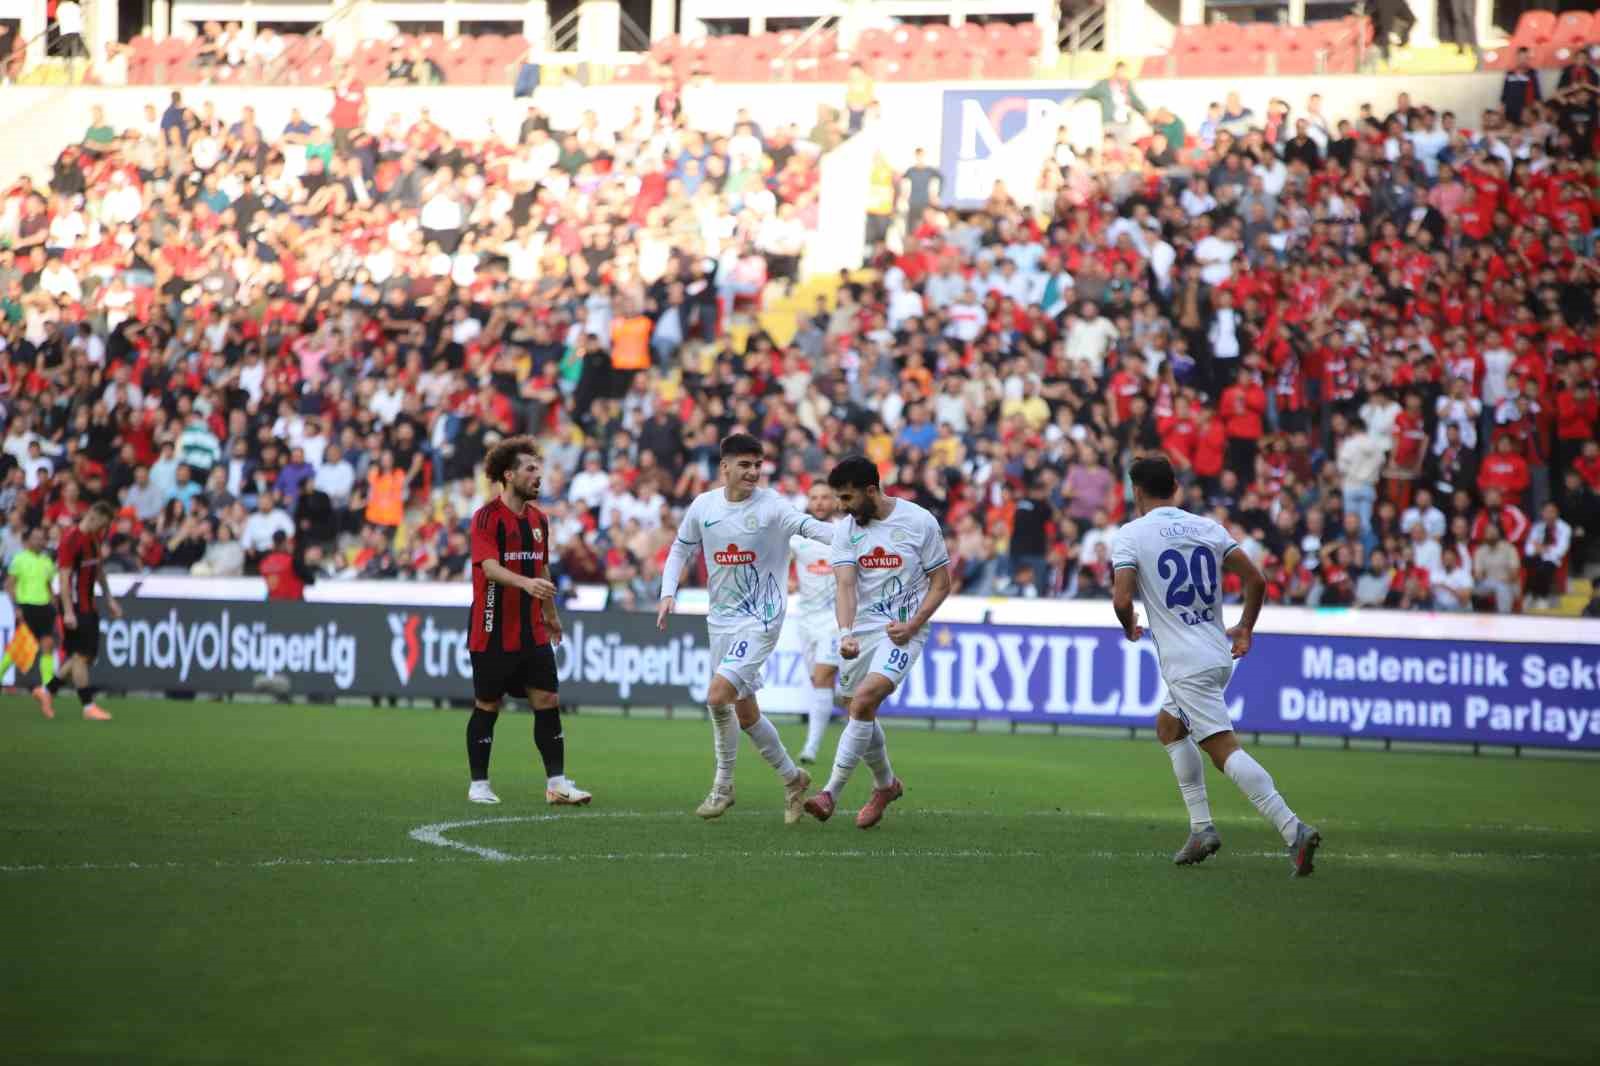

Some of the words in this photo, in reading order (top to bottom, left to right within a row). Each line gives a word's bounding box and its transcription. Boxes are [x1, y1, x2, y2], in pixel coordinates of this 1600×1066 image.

[1157, 545, 1217, 609] 20
[99, 607, 229, 682] endyol
[728, 640, 748, 658] 18
[888, 648, 909, 670] 99
[1302, 646, 1508, 687] Madencilik
[1522, 654, 1600, 690] Sek
[1279, 687, 1451, 732] Dünyanın
